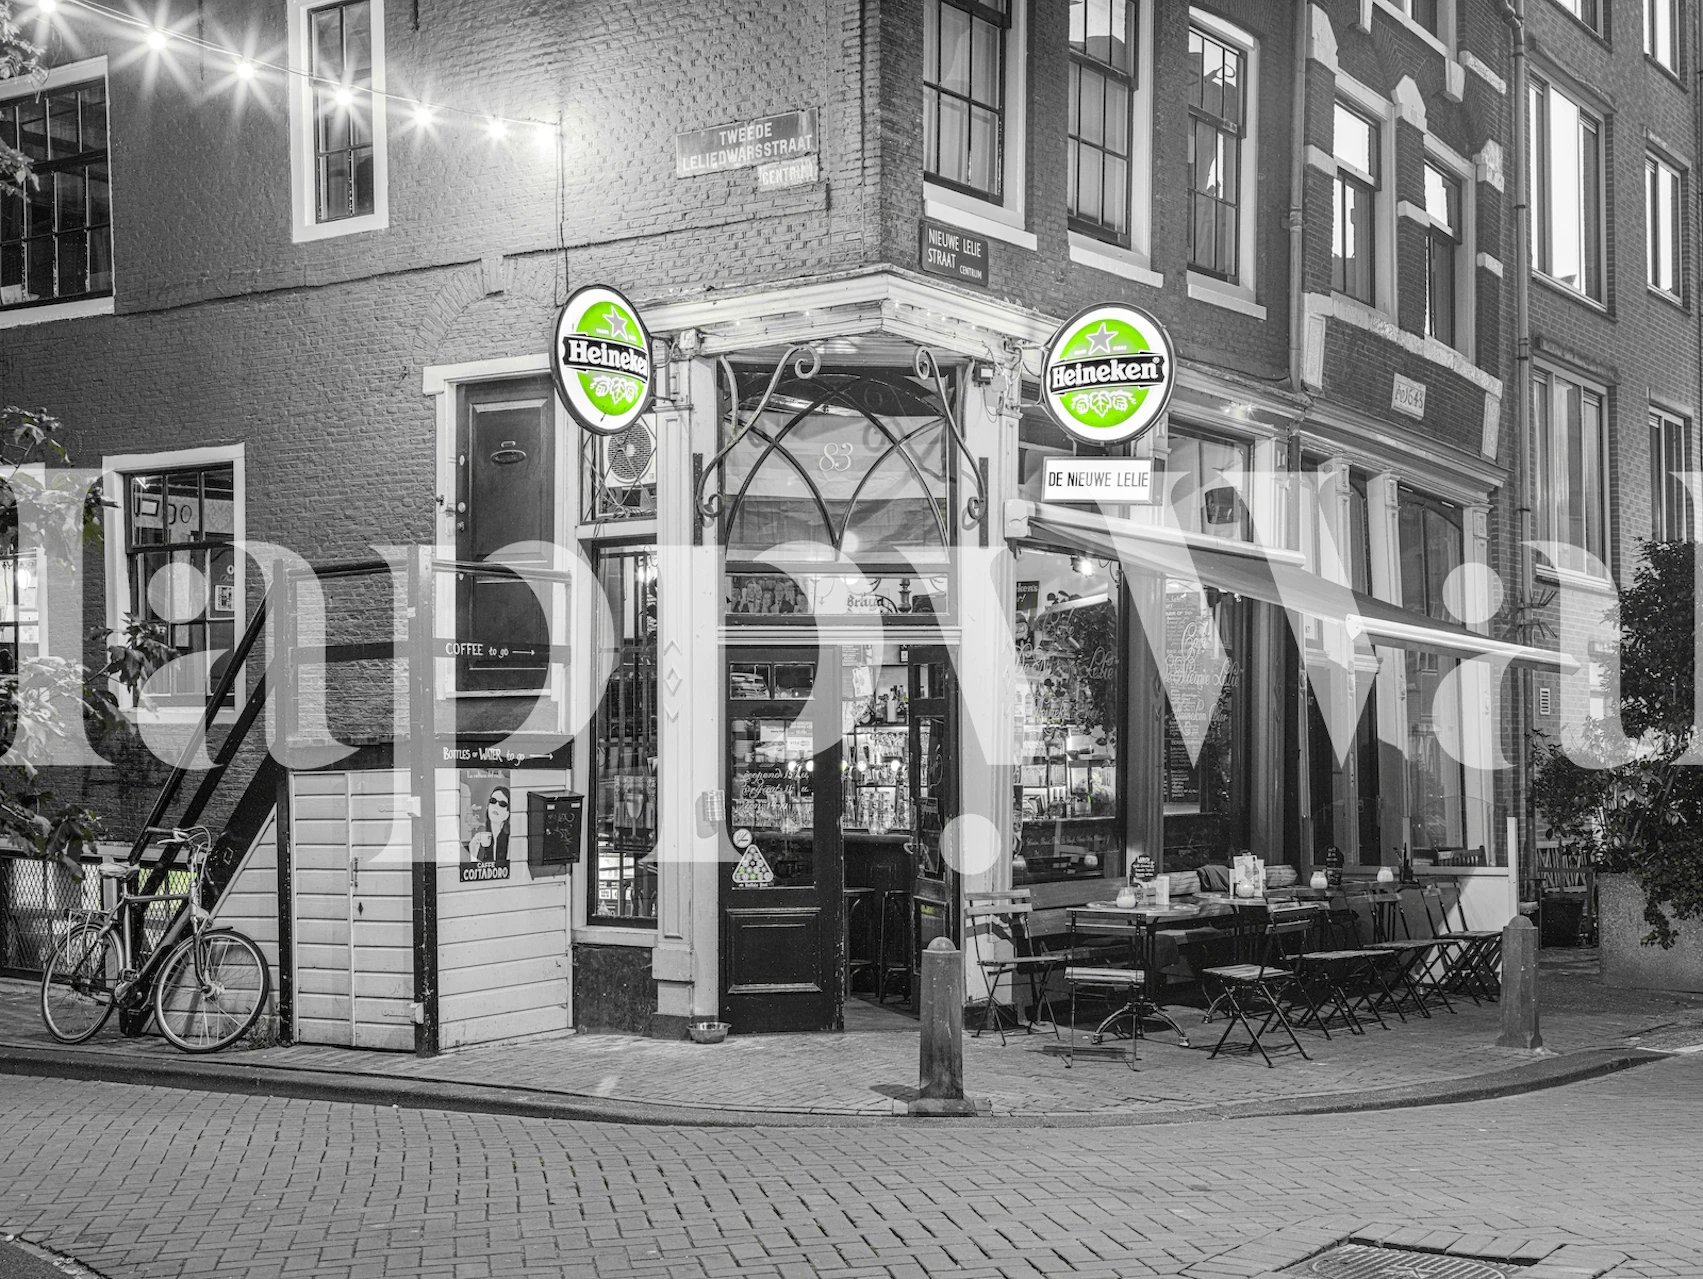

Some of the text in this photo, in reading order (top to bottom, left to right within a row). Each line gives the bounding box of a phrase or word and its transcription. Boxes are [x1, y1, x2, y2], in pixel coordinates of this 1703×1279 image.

[719, 122, 773, 146] TWEEDE
[682, 134, 813, 172] LELIEDWARSSTRAAT
[928, 228, 982, 258] NIEUWE LELIE
[927, 247, 957, 269] STRAAT
[960, 265, 982, 280] CENTRUM
[1051, 359, 1160, 389] Heineken
[819, 442, 854, 472] 83
[1048, 471, 1150, 487] DE NIEUWE LELIE
[445, 642, 509, 659] COFFEE to go
[443, 747, 470, 760] BOTTLES
[478, 747, 503, 762] WATER
[506, 749, 515, 762] to
[516, 752, 526, 766] go
[463, 867, 508, 881] COSTADORO
